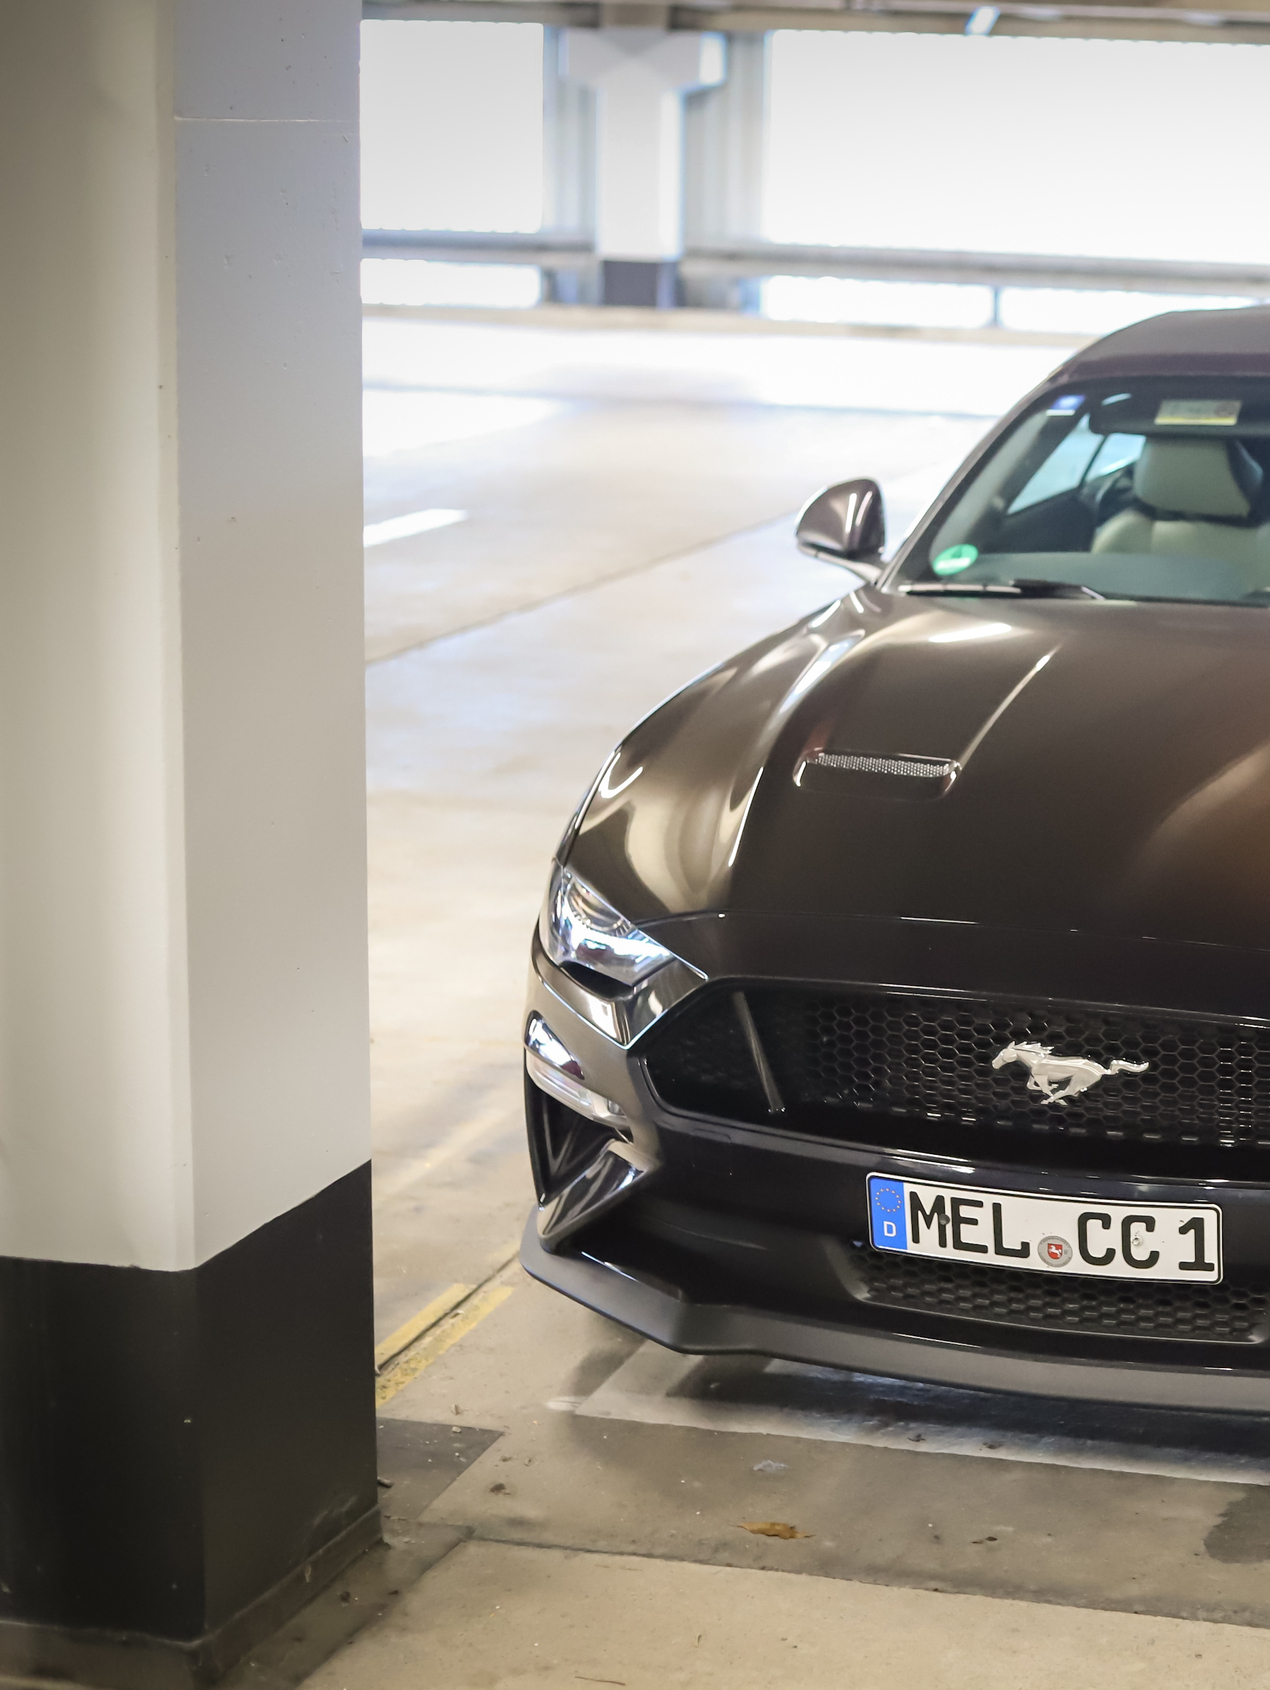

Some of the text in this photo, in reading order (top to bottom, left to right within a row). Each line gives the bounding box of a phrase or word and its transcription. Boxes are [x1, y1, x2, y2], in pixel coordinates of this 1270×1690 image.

[883, 1221, 896, 1237] D
[909, 1191, 1030, 1258] MEL
[1077, 1211, 1160, 1269] CC
[1178, 1216, 1215, 1272] 1
